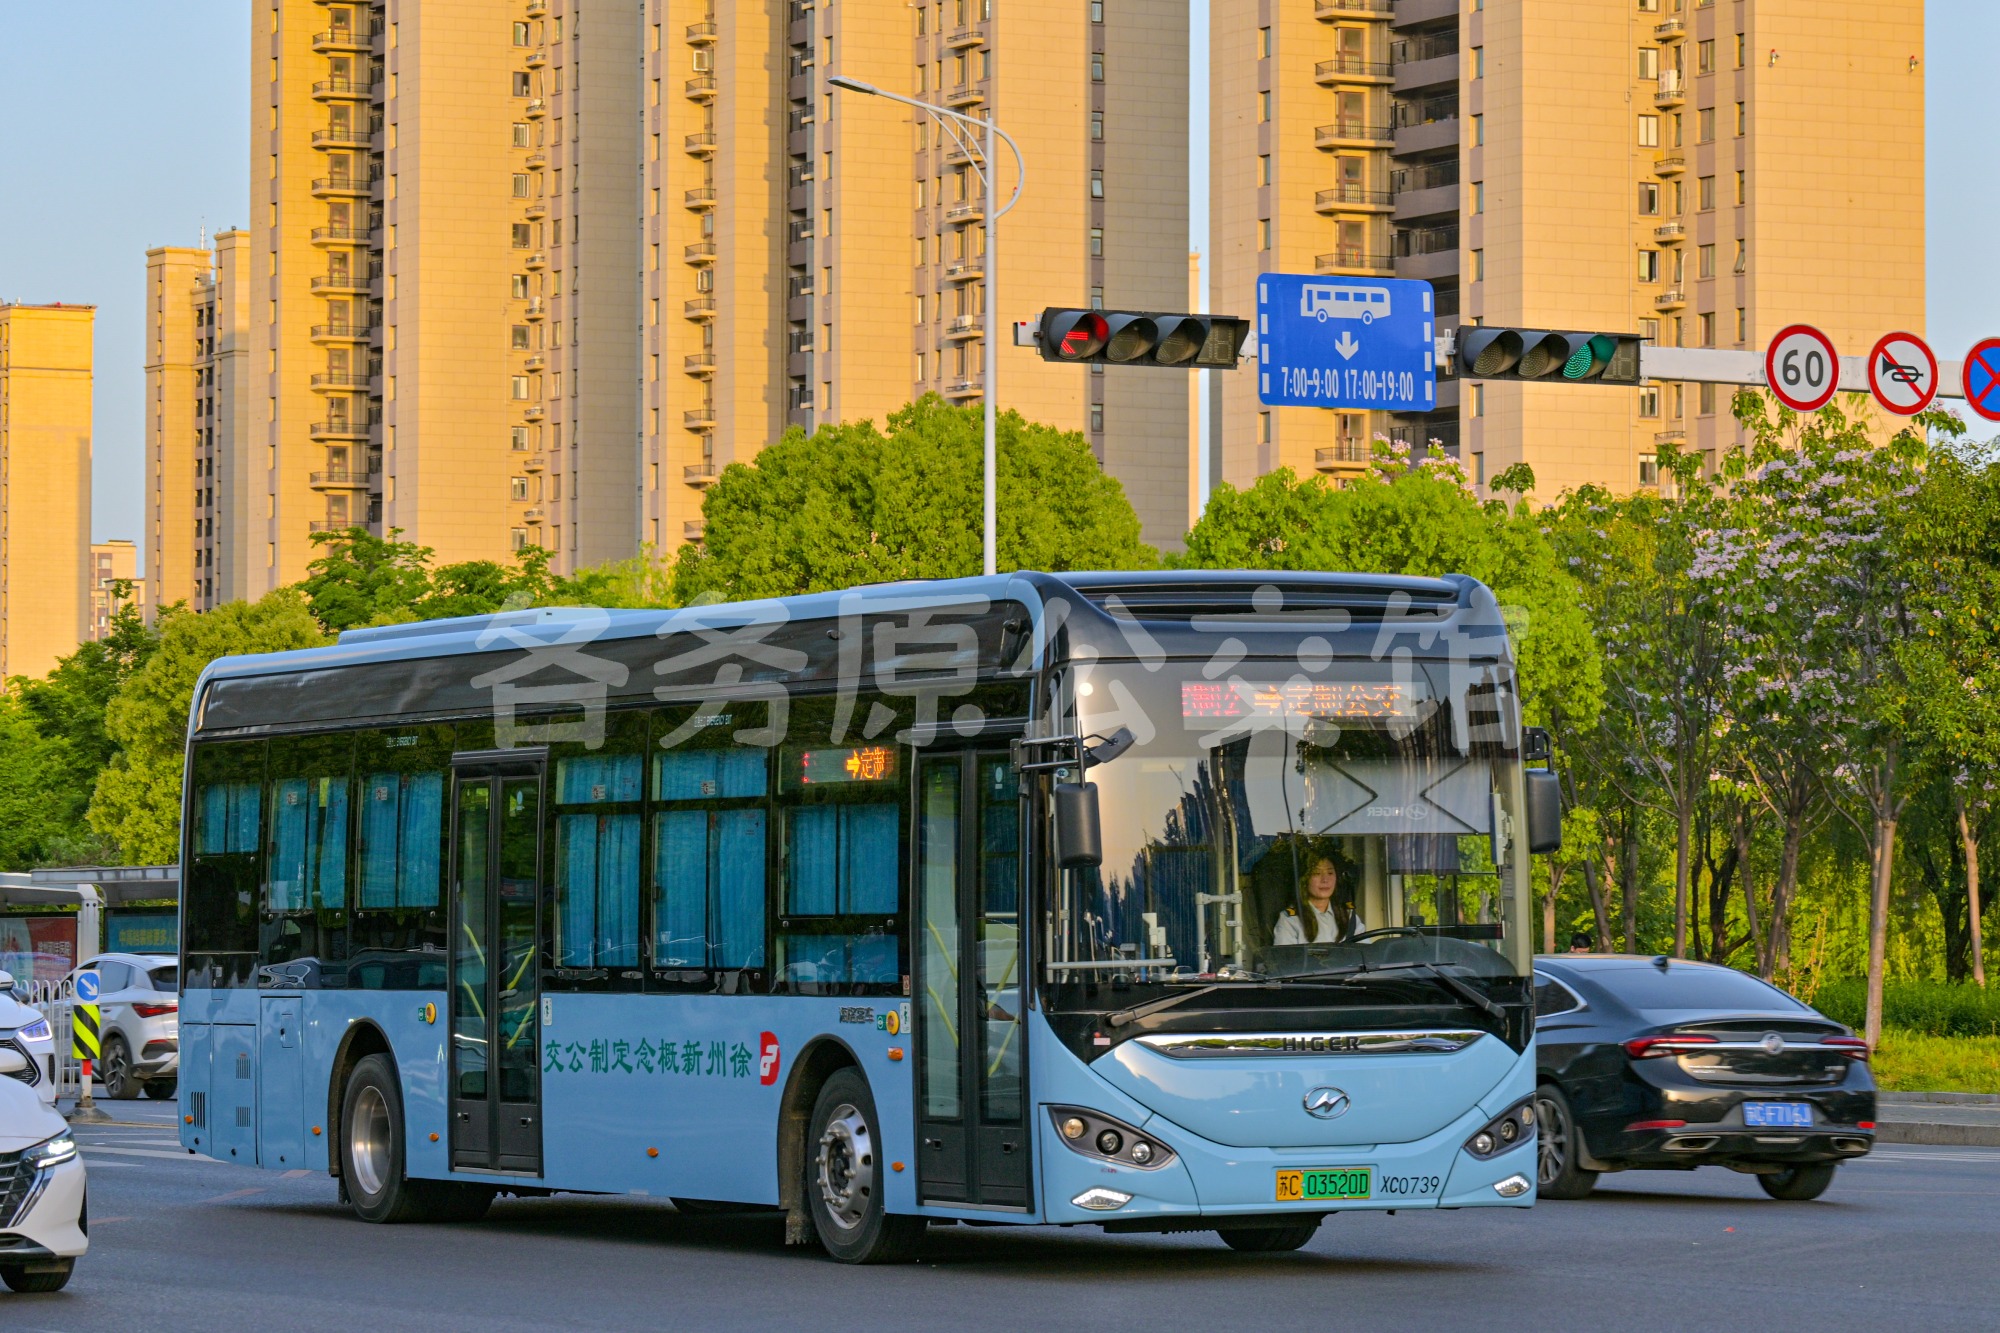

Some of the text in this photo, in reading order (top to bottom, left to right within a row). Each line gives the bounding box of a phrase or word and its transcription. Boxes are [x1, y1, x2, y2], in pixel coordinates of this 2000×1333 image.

[1782, 349, 1824, 387] 60
[1281, 366, 1414, 402] 7:00-9:00 17:00-19:00
[1283, 1036, 1360, 1052] HIGER
[1380, 1175, 1440, 1195] XC0739
